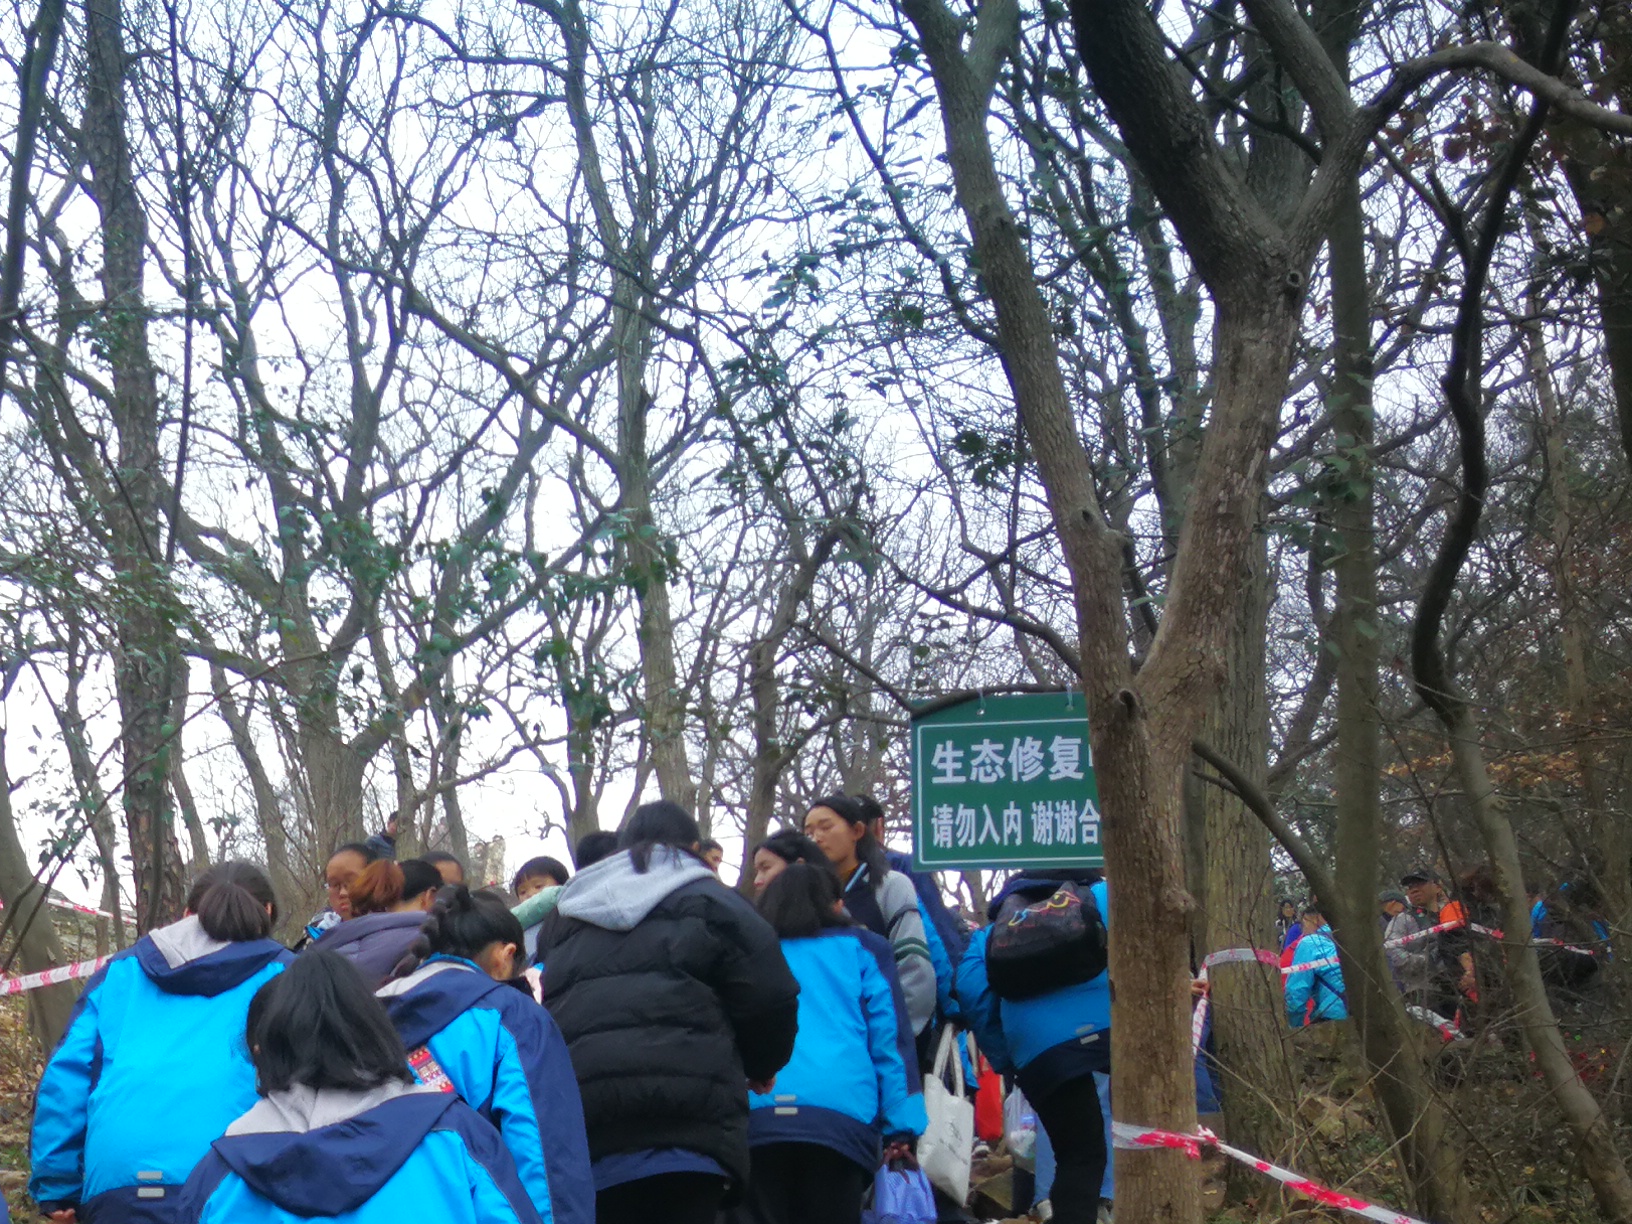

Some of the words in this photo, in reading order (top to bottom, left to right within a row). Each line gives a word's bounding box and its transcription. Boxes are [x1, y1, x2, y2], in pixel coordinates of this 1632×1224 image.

[930, 735, 1094, 785] 生态修复
[930, 802, 1023, 849] 请勿入内
[1030, 798, 1101, 846] 谢谢合
